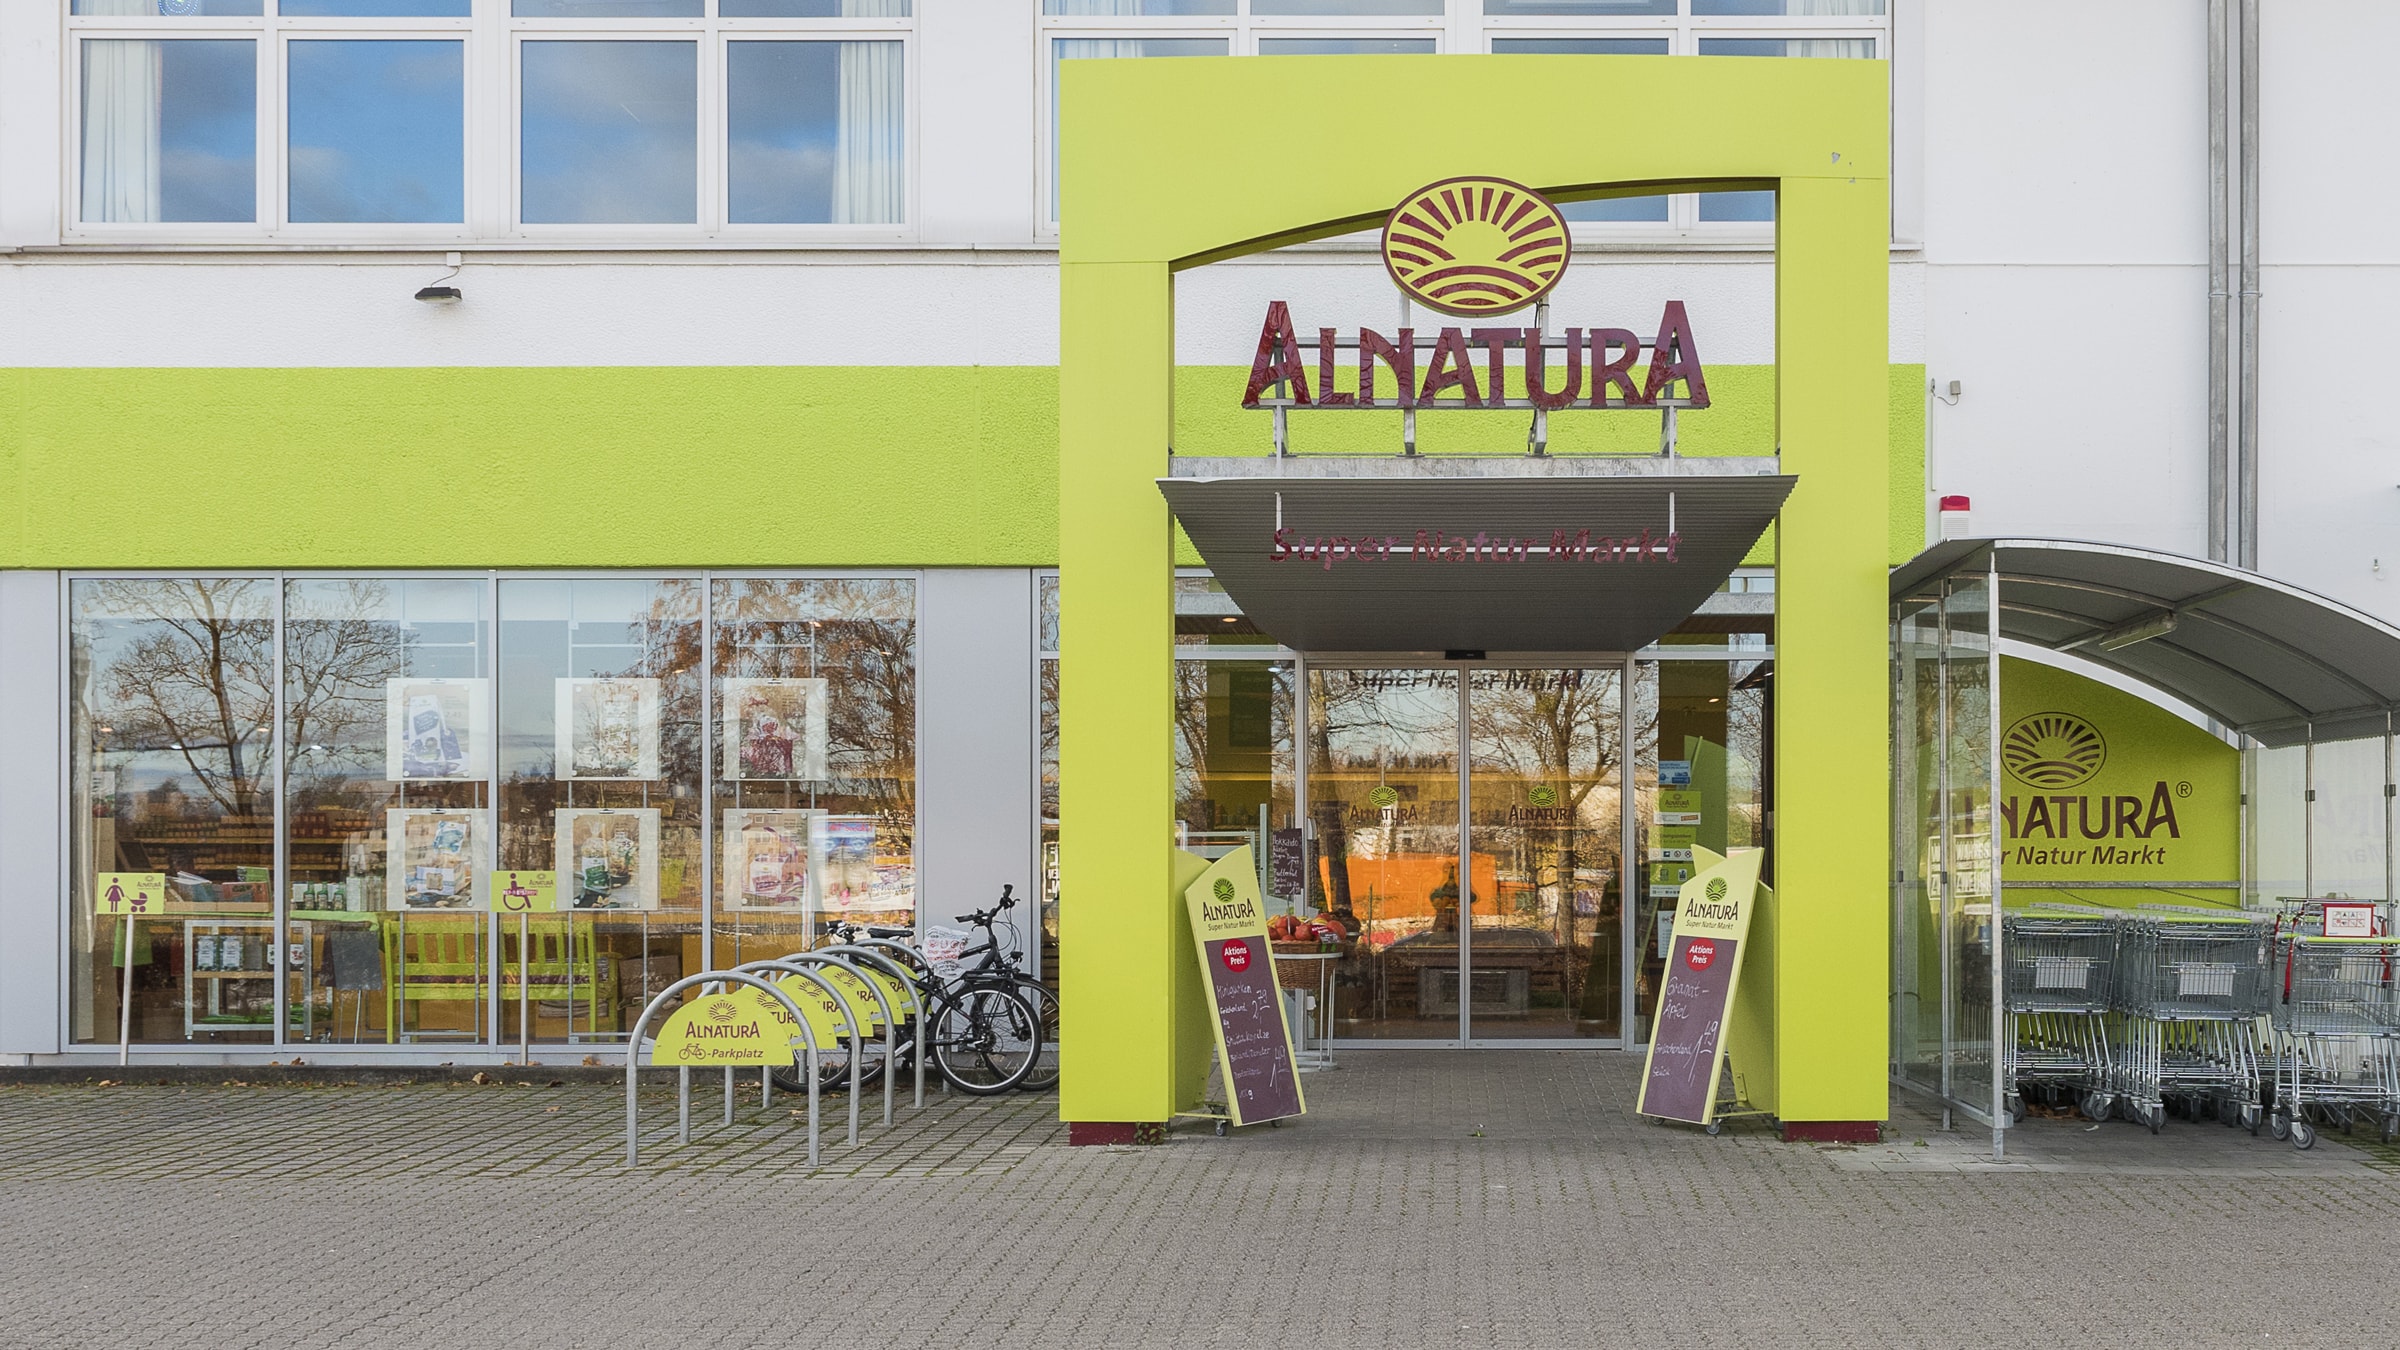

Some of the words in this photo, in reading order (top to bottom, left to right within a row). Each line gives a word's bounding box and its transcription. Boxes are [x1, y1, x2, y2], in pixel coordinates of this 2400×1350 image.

[1240, 300, 1711, 409] ALNATURA
[1270, 527, 1400, 570] Super
[1411, 529, 1538, 564] Natur
[1547, 527, 1685, 564] Markt
[1350, 804, 1418, 821] ALNATURA
[1509, 804, 1577, 821] ALNATURA
[2016, 846, 2086, 865] Natur
[2091, 844, 2166, 865] Markt
[1203, 898, 1256, 921] ALNATURA
[1685, 897, 1738, 921] ALNATURA
[1208, 923, 1223, 932] Super
[1239, 920, 1255, 928] Markt
[1685, 920, 1701, 928] Super
[1717, 922, 1734, 930] Markt
[1224, 946, 1247, 956] Aktions
[1689, 945, 1714, 955] Aktions
[1230, 956, 1245, 965] Preis
[1691, 955, 1708, 964] Preis
[685, 1021, 760, 1038] ALNATURA
[707, 1048, 764, 1060] -Parkplatz
